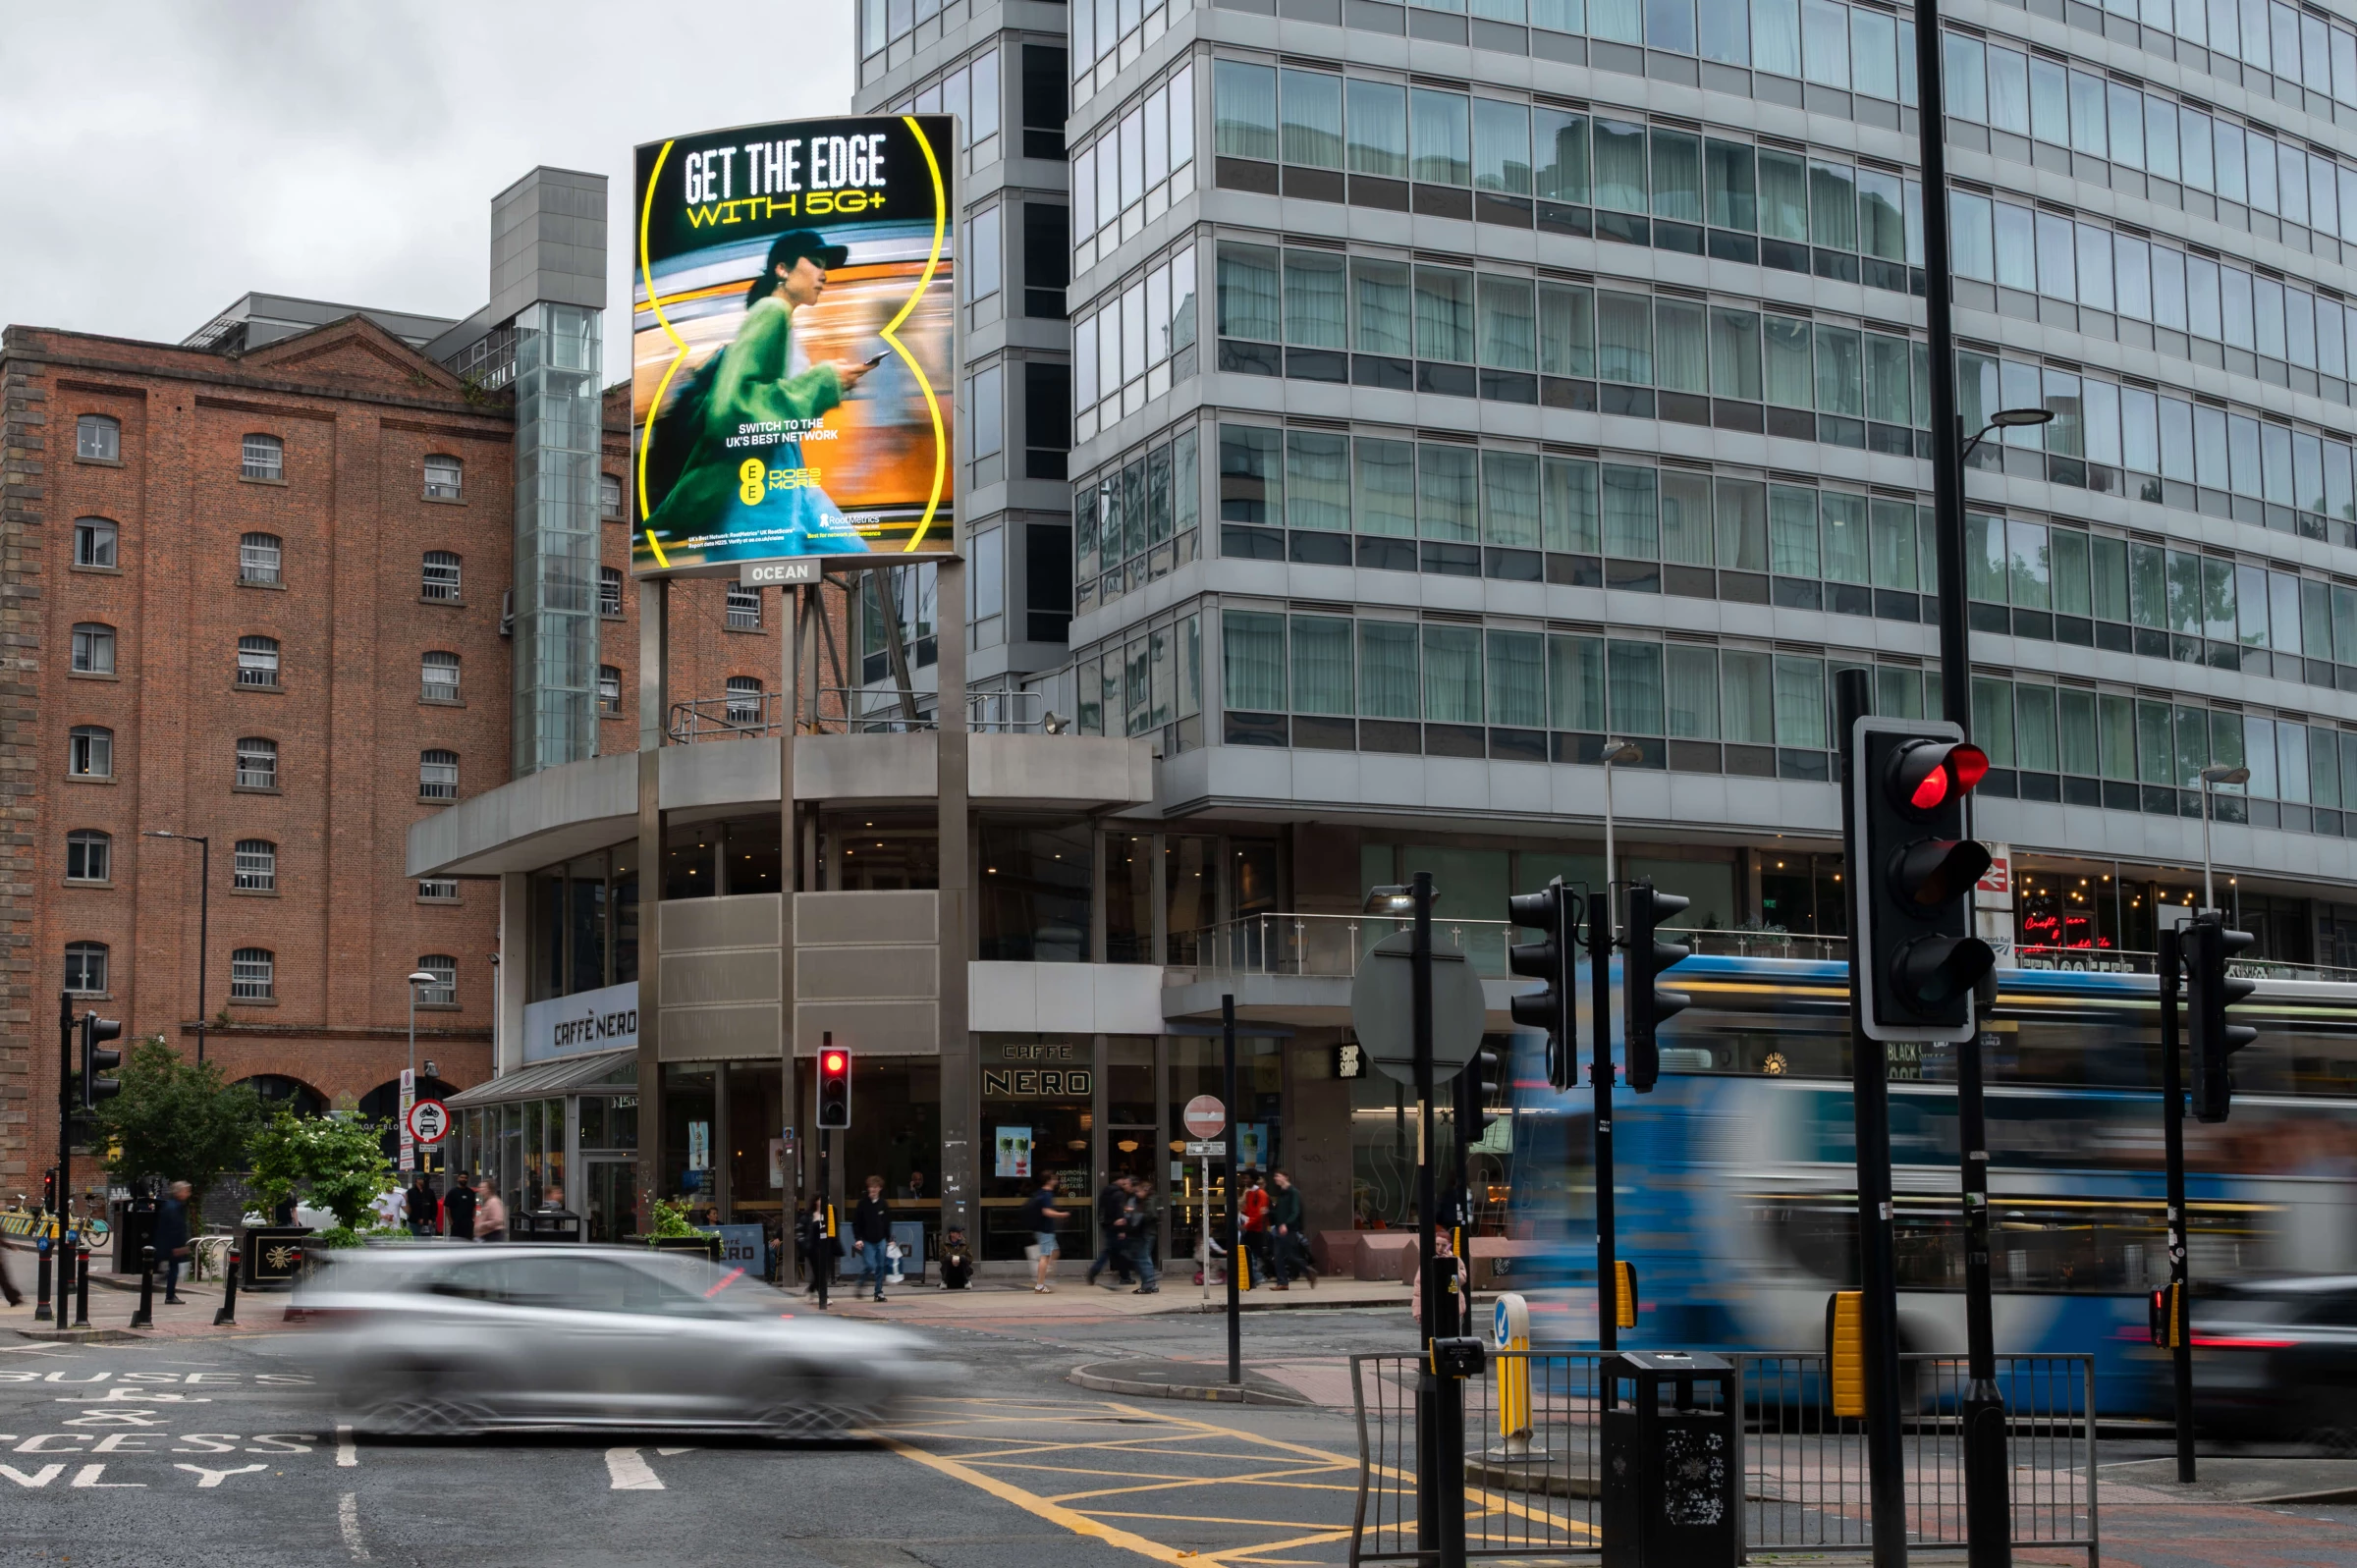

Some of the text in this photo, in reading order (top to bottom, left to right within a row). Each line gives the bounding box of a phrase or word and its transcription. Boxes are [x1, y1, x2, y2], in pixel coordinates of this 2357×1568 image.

[685, 134, 886, 204] GET THE EDGE
[686, 189, 886, 229] WITH 5G+
[739, 418, 824, 434] SWITCH TO THE
[726, 429, 838, 448] UK'S BEST NETWORK
[769, 467, 821, 480] DOES
[769, 477, 821, 491] MORE
[751, 565, 808, 580] OCEAN
[2024, 916, 2057, 931] Craft
[554, 1007, 636, 1048] CAFFÈ NERO
[1003, 1040, 1072, 1059] CAFFÈ
[1343, 1045, 1359, 1061] CHIP
[1887, 1043, 1917, 1061] BLACK
[1340, 1060, 1359, 1077] SHOP
[984, 1069, 1091, 1096] NERO
[62, 1409, 174, 1426] &
